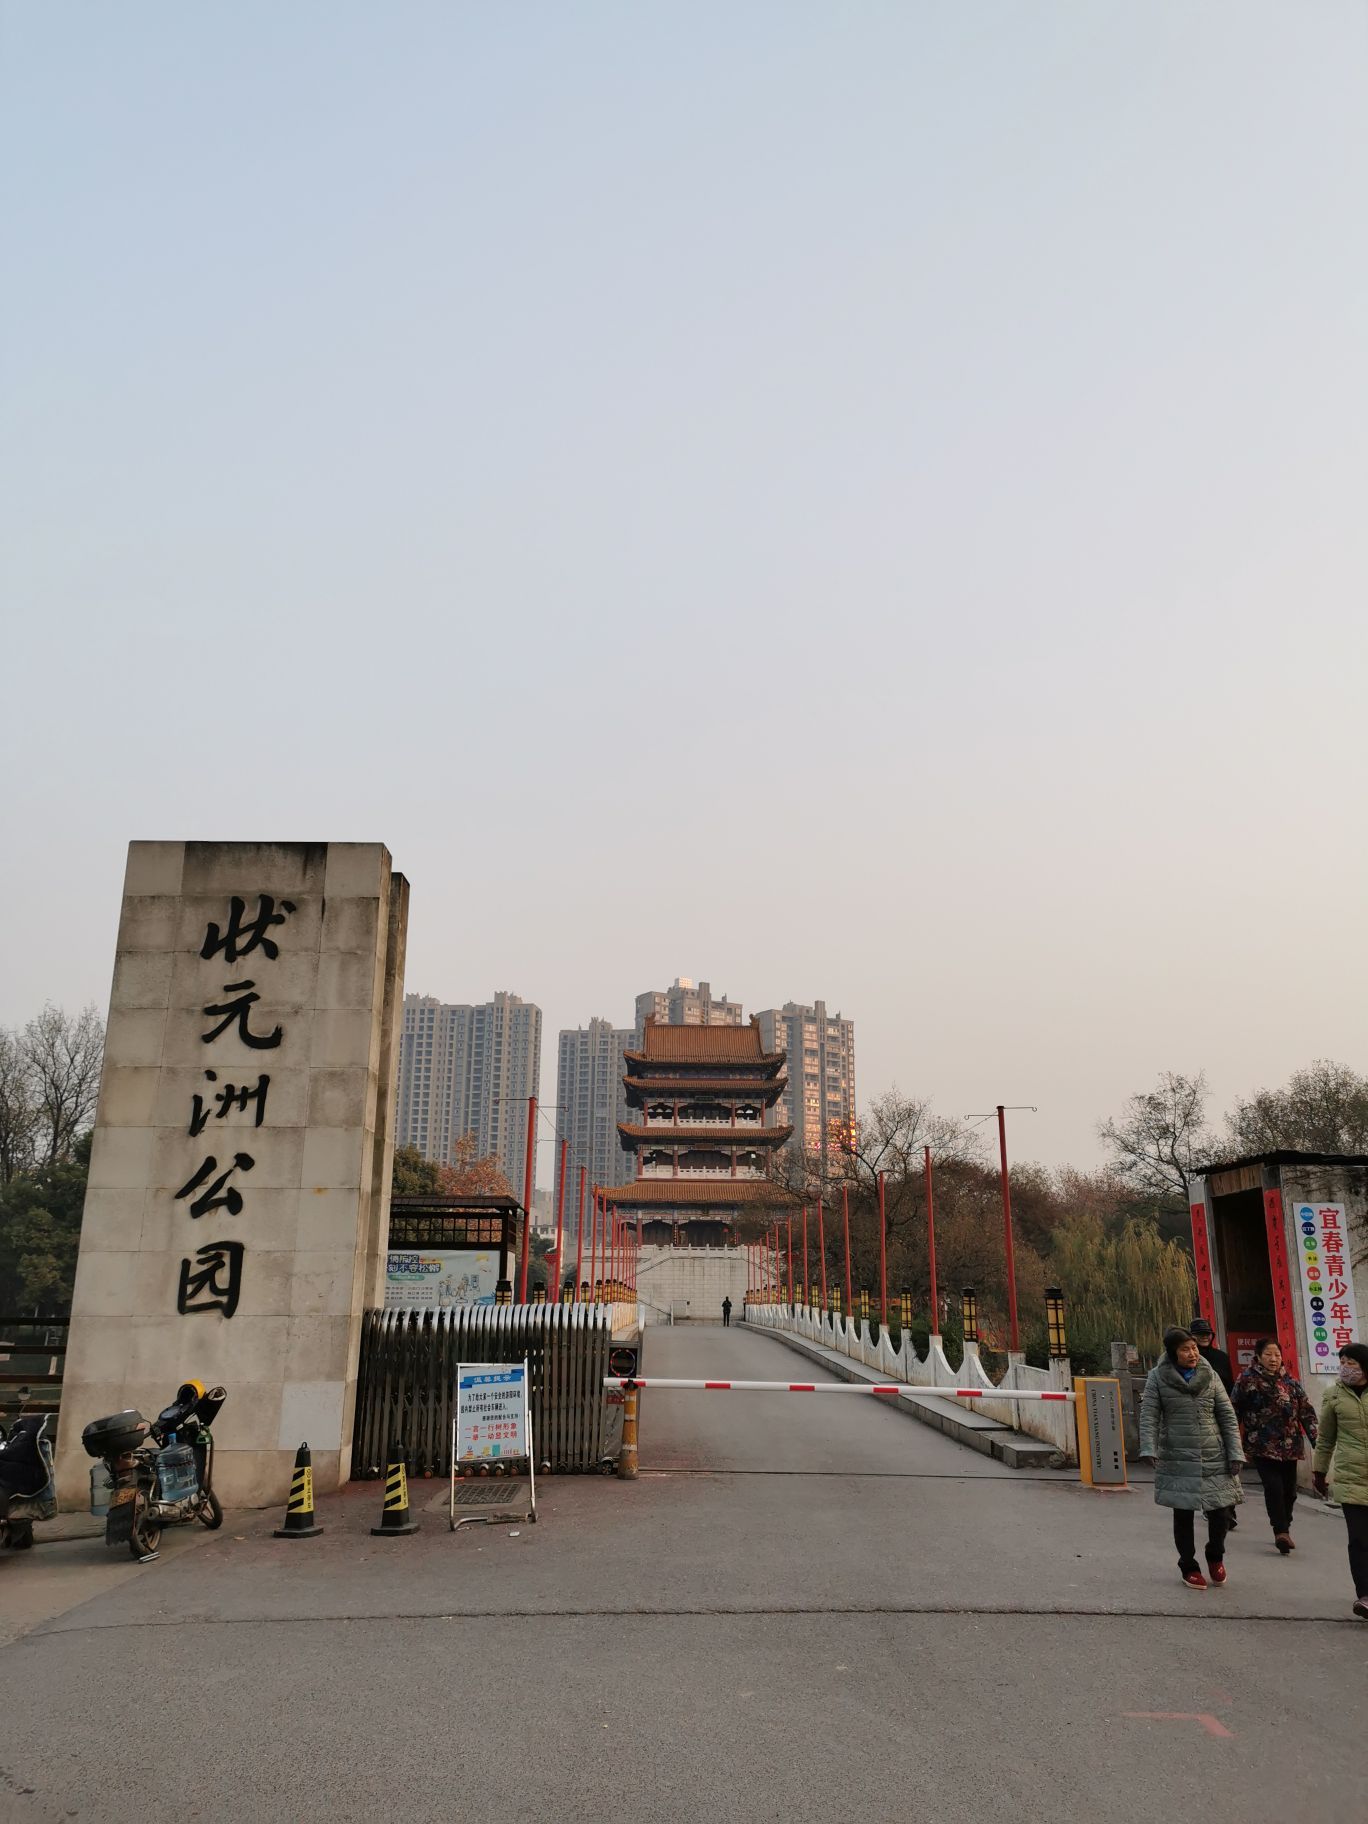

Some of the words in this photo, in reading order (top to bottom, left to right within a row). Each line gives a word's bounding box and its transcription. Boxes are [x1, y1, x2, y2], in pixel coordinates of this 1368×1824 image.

[175, 894, 296, 1319] 状元洲公园
[1318, 1207, 1354, 1348] 宜春青少年宫
